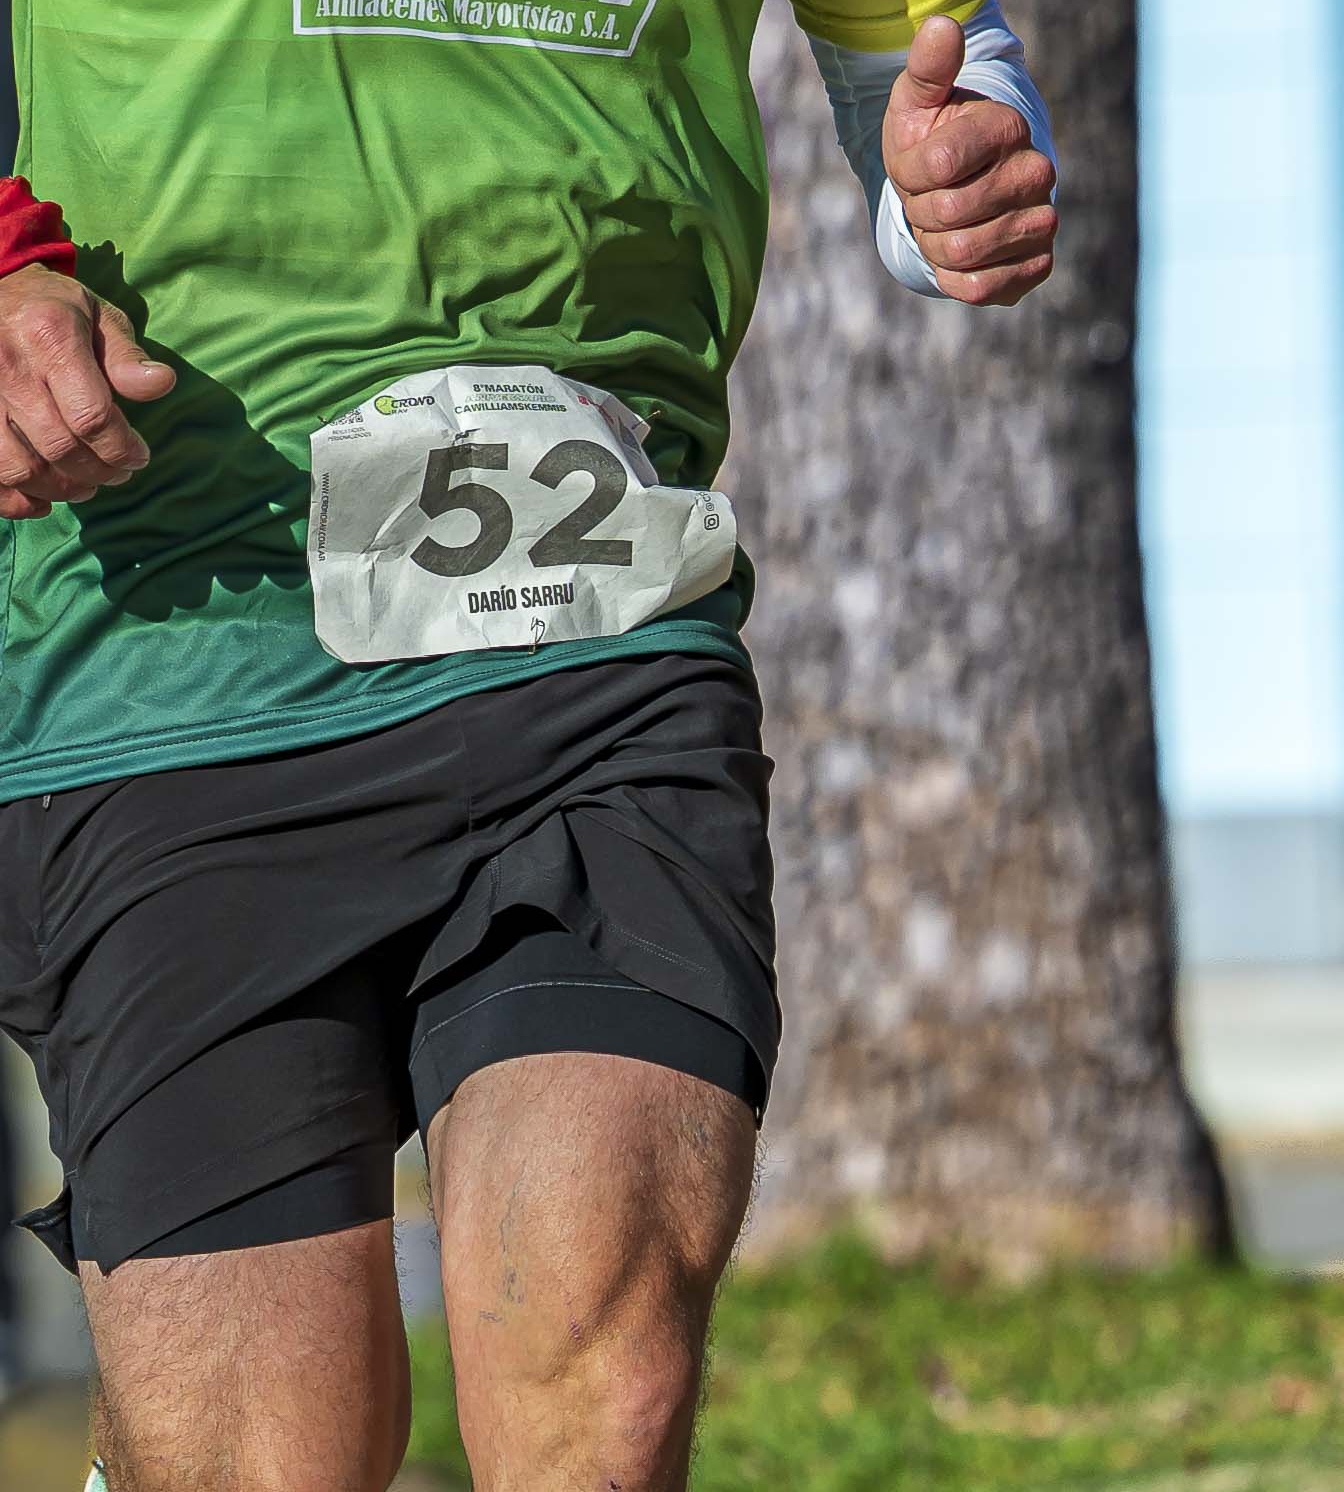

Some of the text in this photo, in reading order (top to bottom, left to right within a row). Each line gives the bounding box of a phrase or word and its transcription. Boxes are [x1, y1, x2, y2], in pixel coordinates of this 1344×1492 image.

[580, 9, 622, 41] S.A.
[391, 395, 436, 409] CRONO
[454, 402, 568, 415] CAWILLIAMSKEMMIS
[410, 439, 633, 578] 52
[467, 582, 575, 614] DARÍO SARRU
